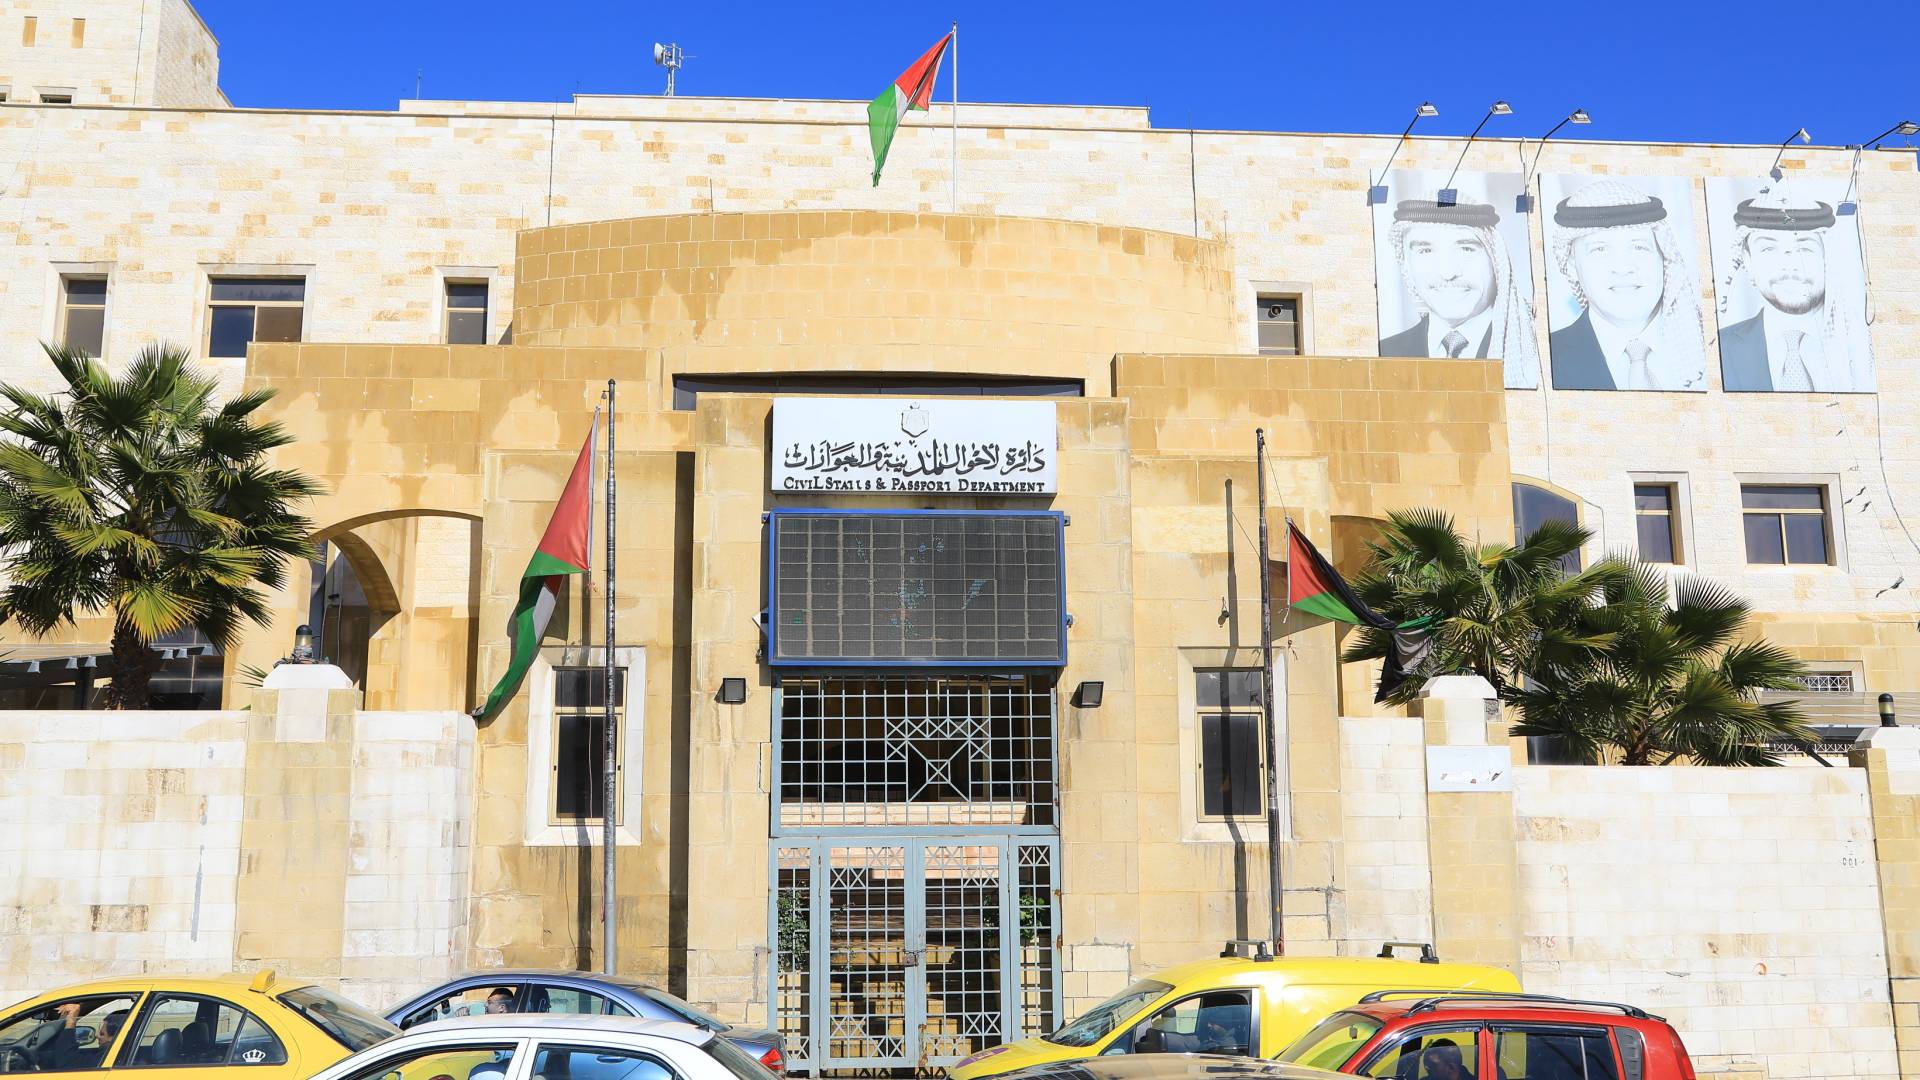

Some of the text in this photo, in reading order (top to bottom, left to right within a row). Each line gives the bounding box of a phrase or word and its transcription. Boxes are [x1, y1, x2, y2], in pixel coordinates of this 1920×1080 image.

[1000, 440, 1045, 475] دائرة
[876, 477, 887, 490] &
[958, 478, 1045, 492] DEPARTMENT
